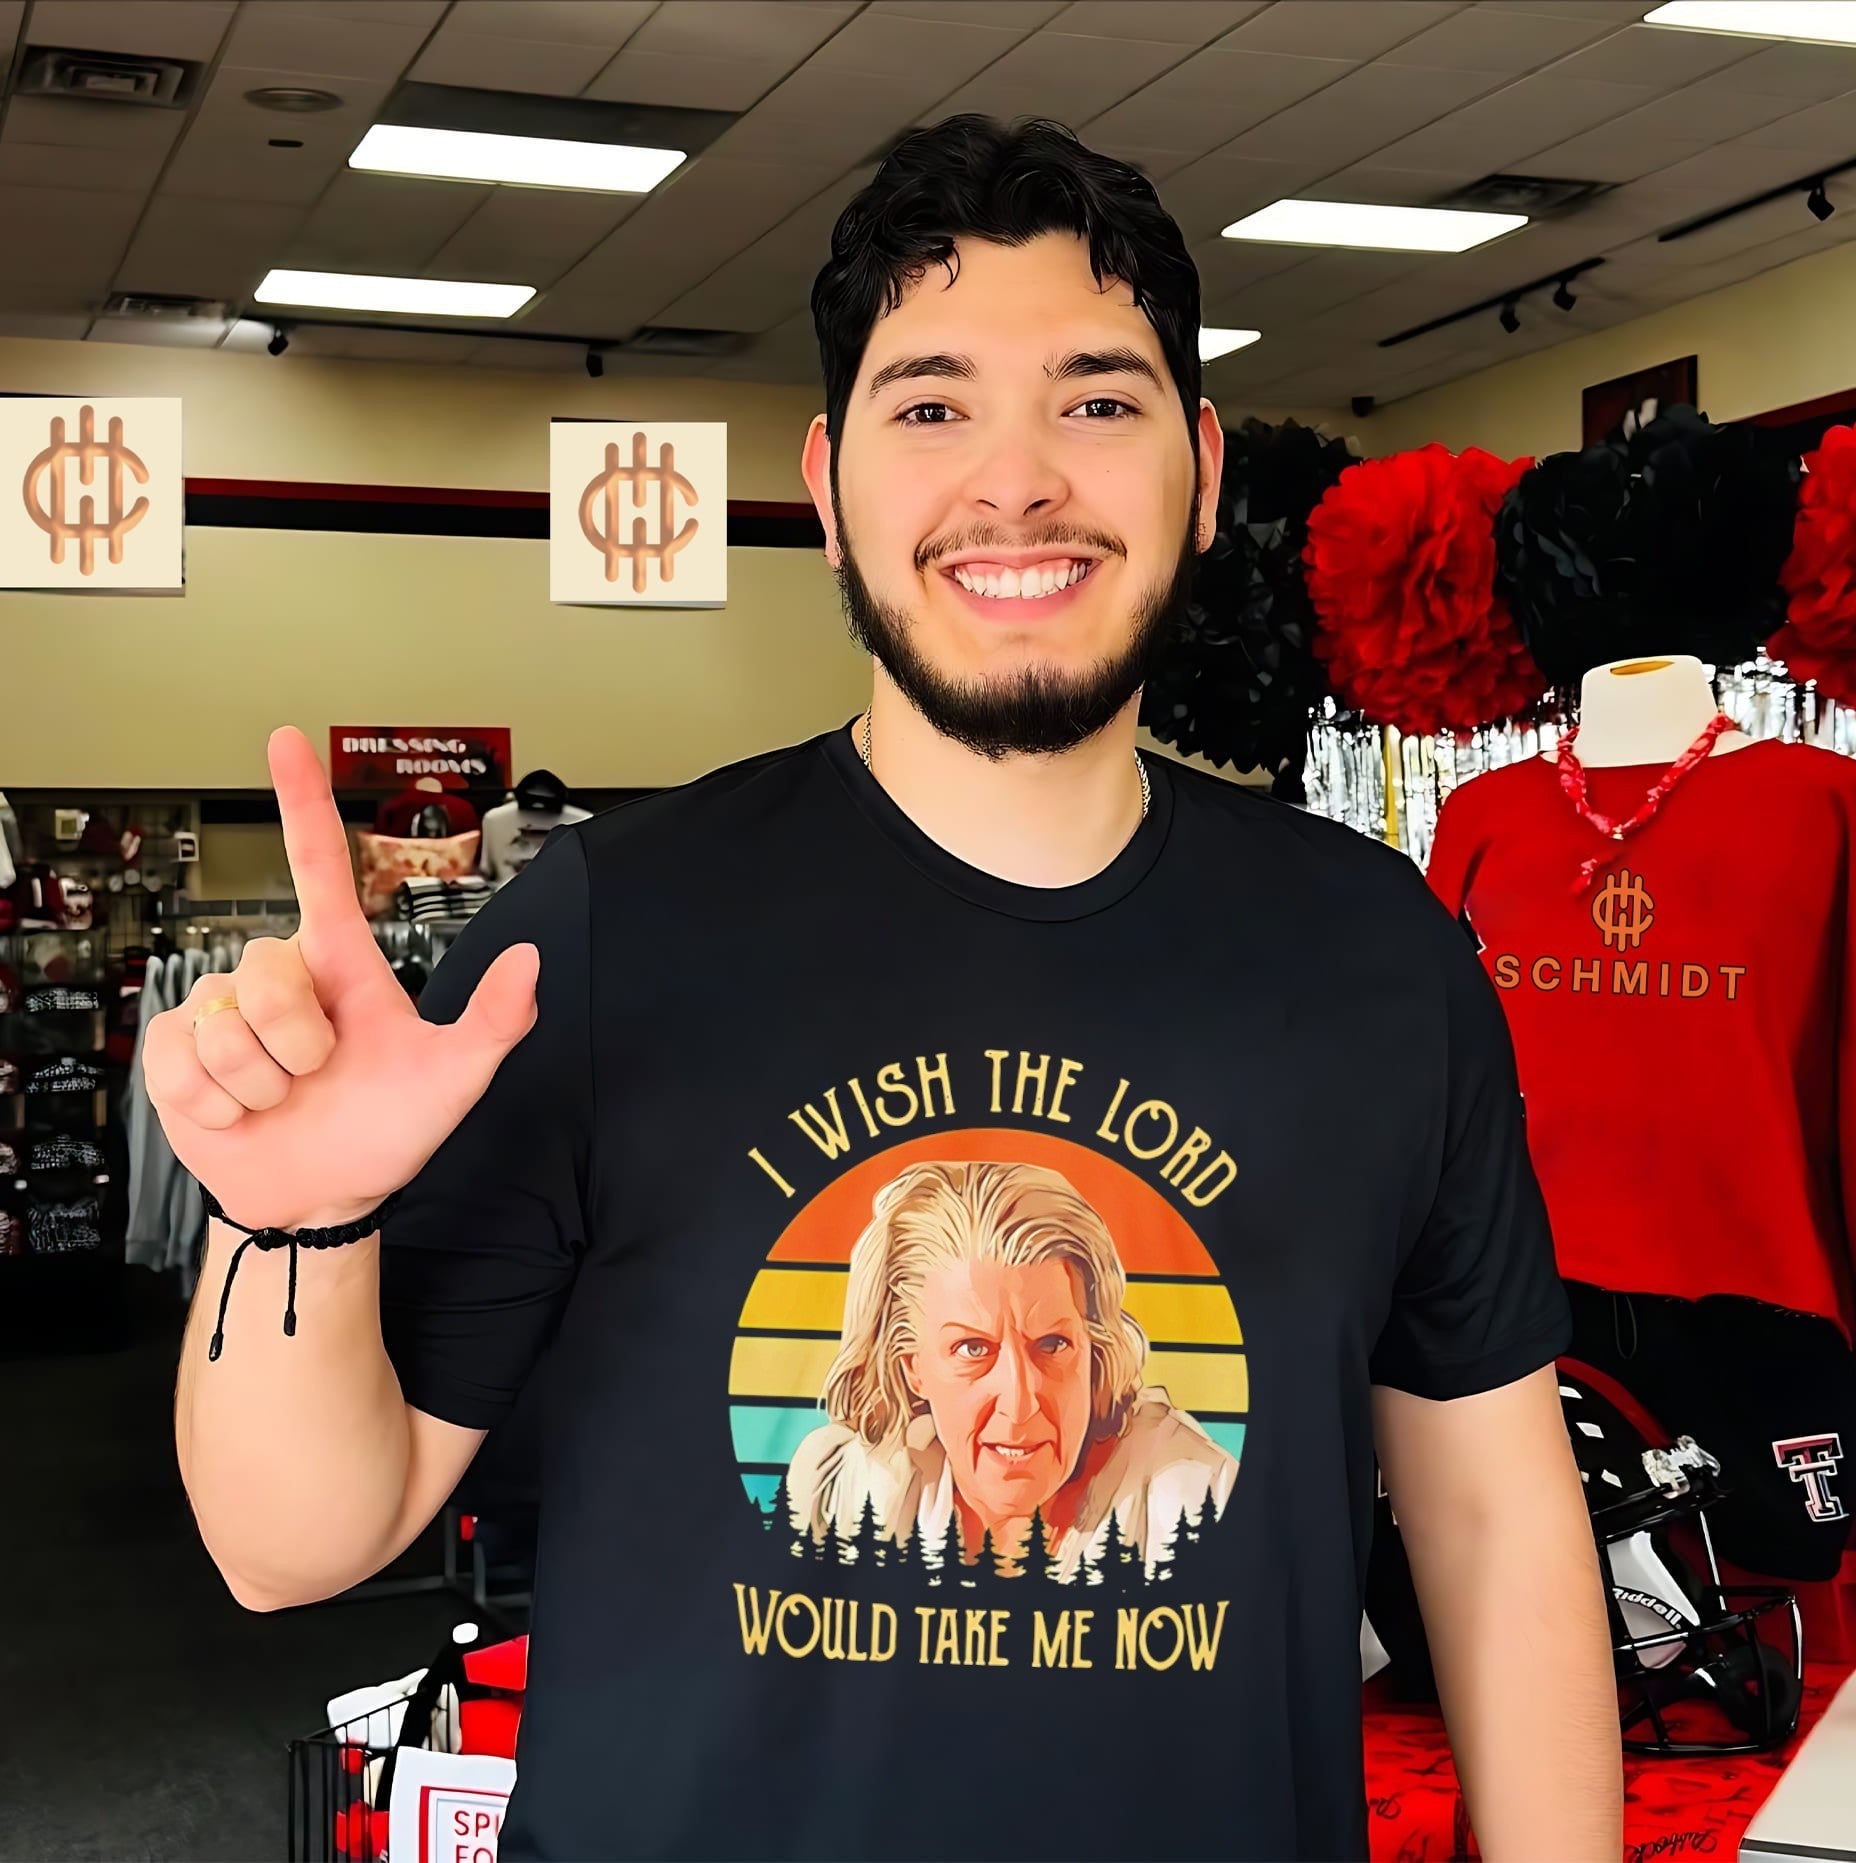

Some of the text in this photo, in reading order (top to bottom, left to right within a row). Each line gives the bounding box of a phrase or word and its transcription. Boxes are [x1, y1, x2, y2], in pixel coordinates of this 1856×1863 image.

[1493, 954, 1748, 1001] SCHMIDT
[747, 1049, 1239, 1208] I WISH THE LORD
[732, 1582, 1231, 1671] WOULD TAKE ME NOW
